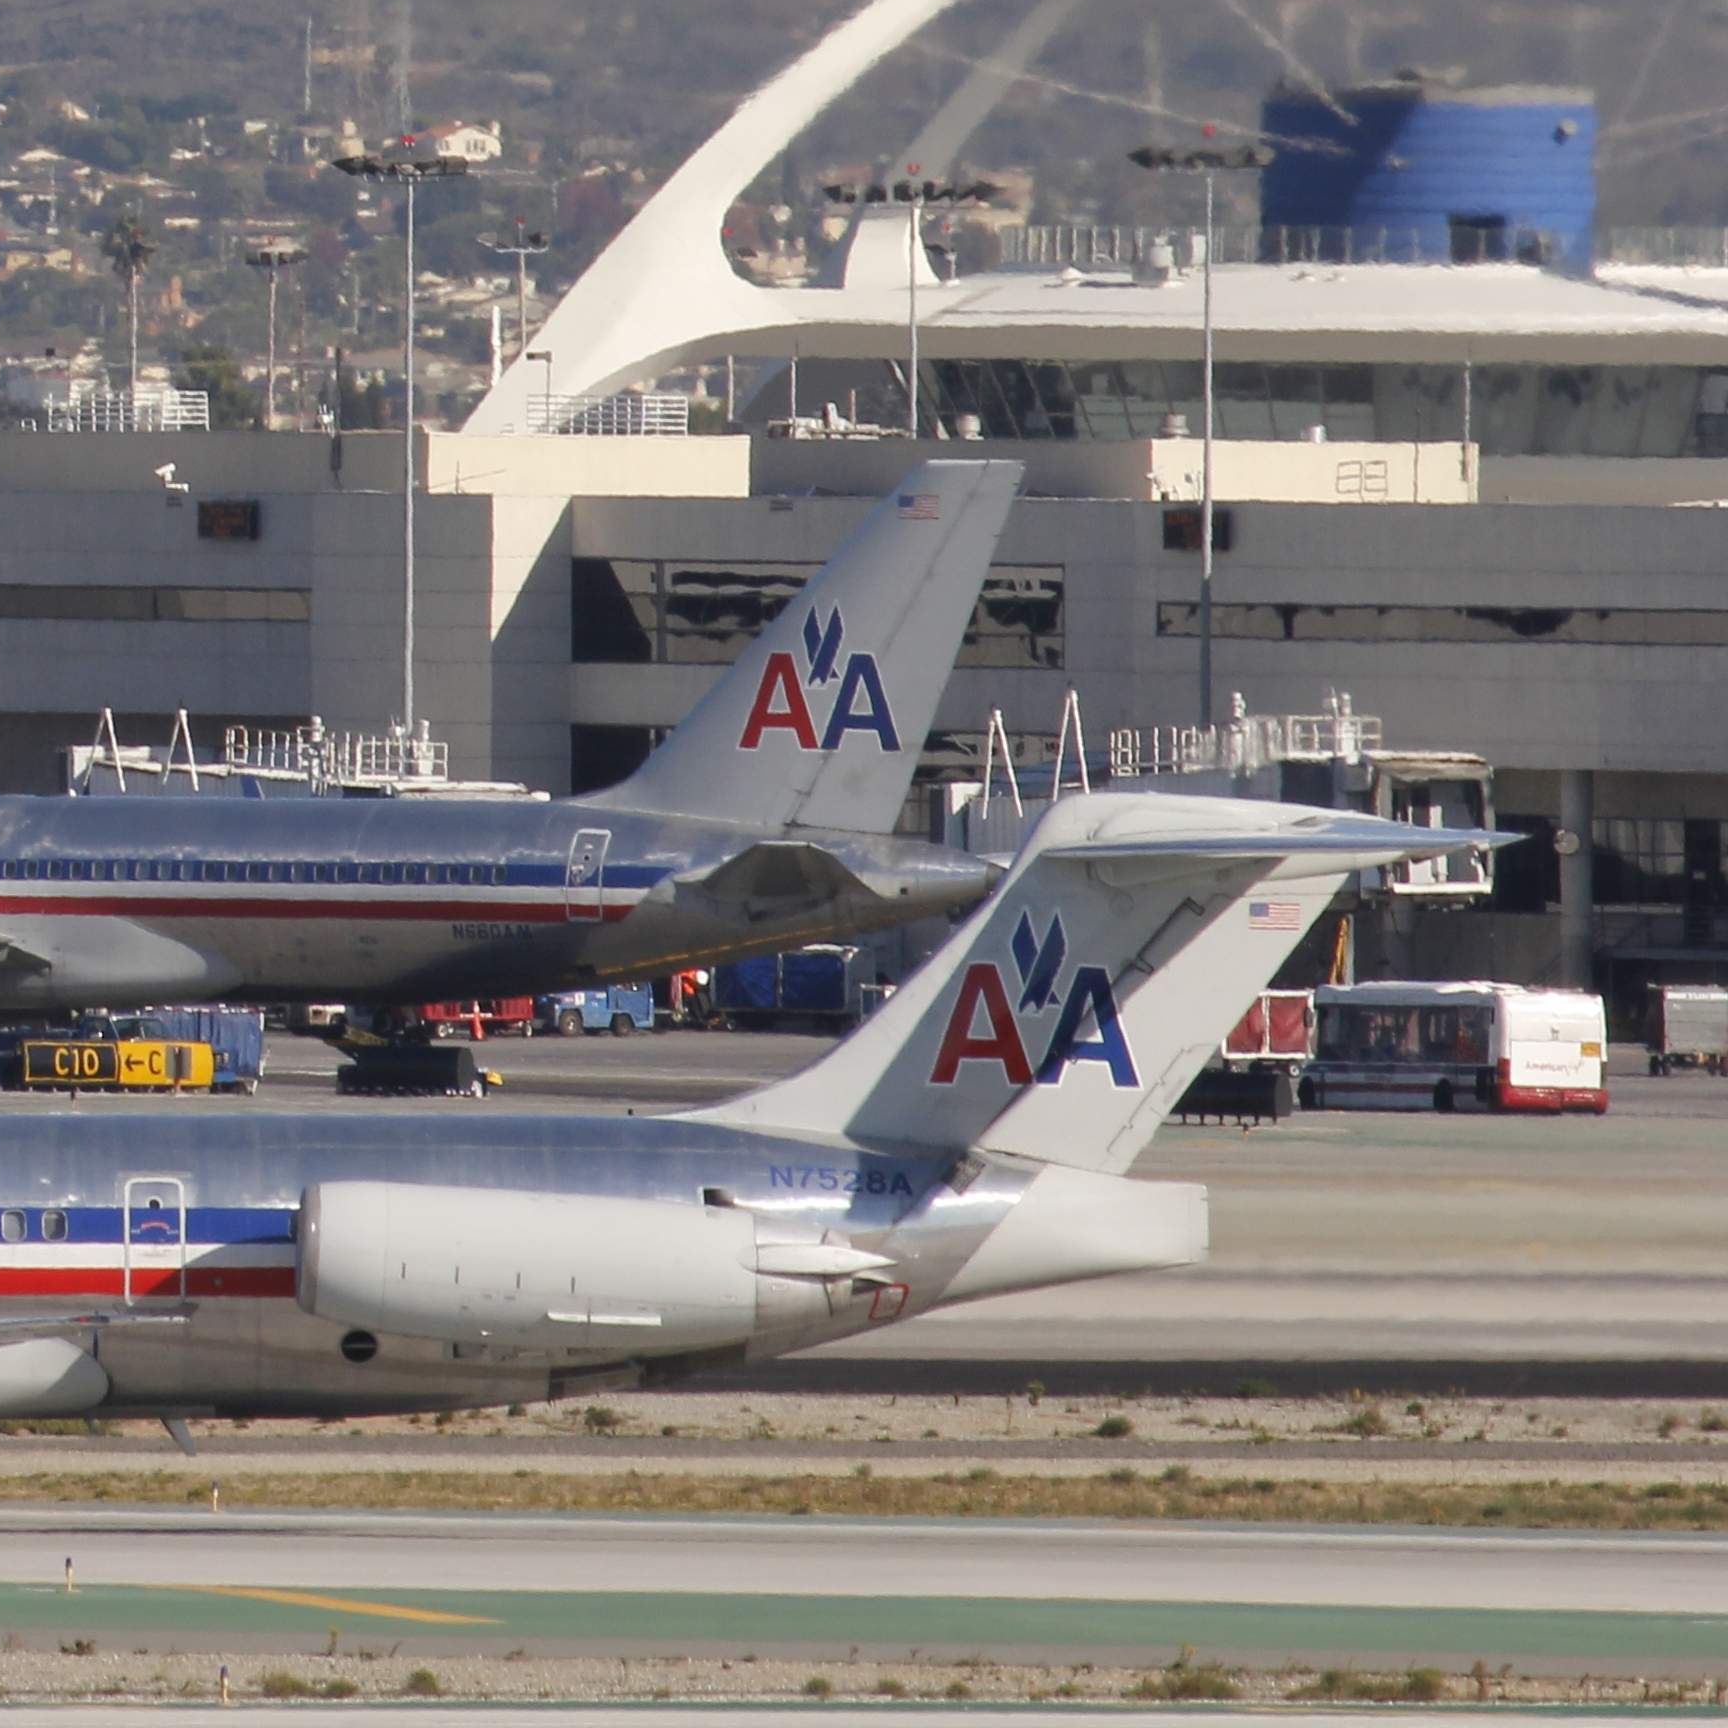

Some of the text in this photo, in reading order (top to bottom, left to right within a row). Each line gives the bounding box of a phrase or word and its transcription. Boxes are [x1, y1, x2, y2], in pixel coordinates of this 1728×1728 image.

[737, 652, 902, 752] AA
[928, 962, 1141, 1088] AA
[55, 1047, 161, 1076] C10 C
[769, 1165, 913, 1197] N7528A
